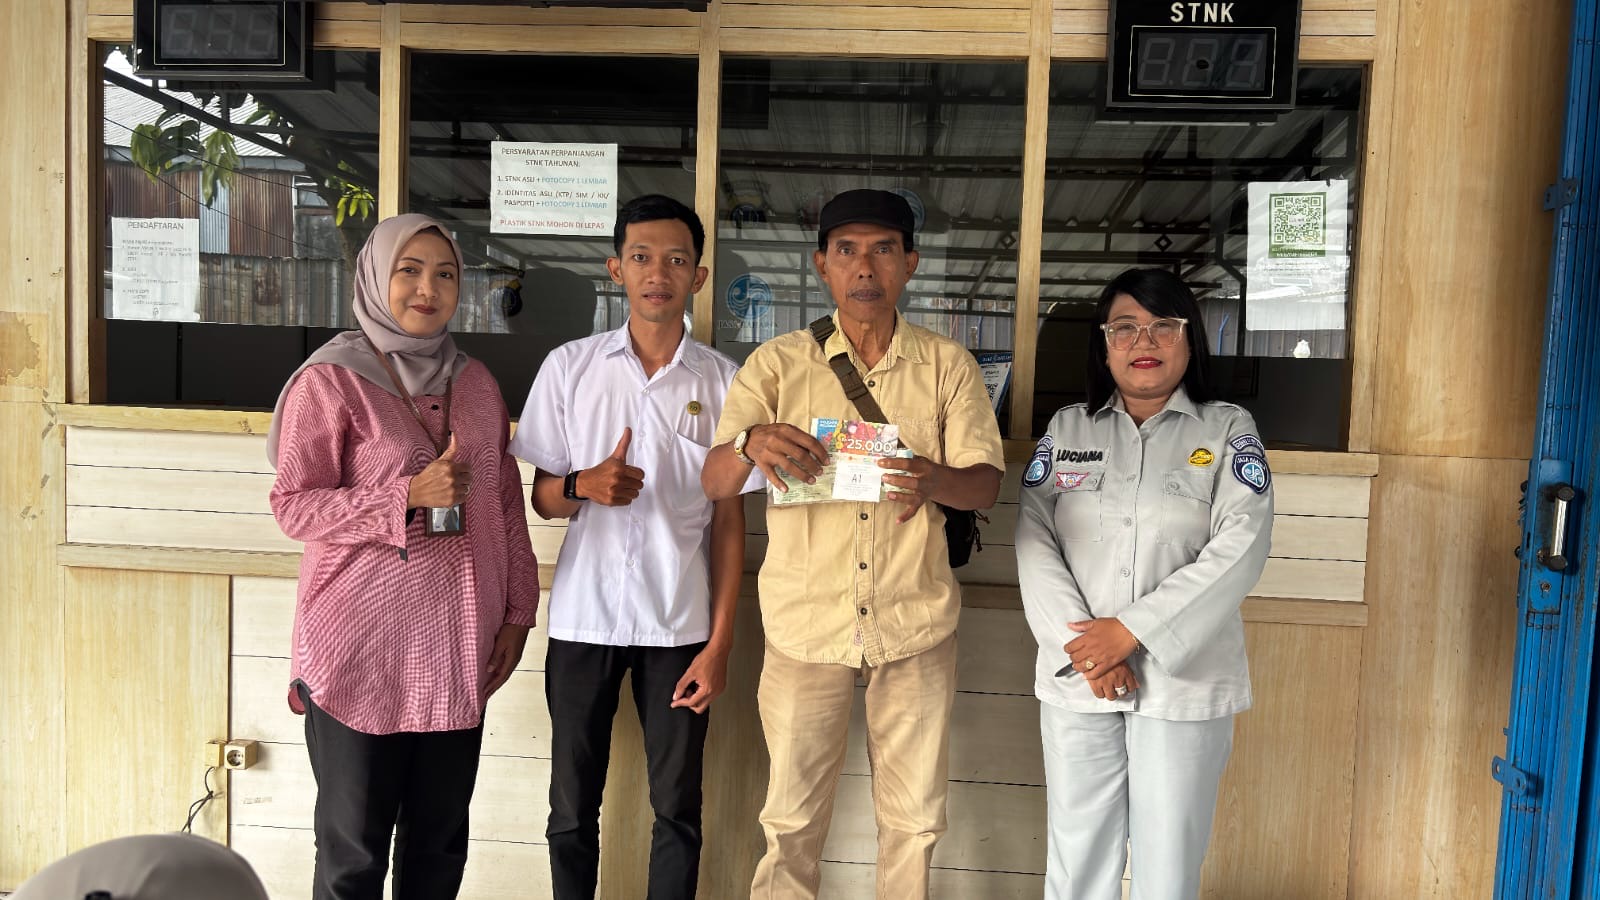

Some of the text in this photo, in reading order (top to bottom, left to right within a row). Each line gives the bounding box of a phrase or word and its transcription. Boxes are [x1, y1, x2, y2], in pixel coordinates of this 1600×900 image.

[1170, 2, 1234, 23] STNK
[502, 148, 605, 157] PERSYARATAN PERPANJANGAN
[127, 221, 184, 230] PENDAFTARAN
[846, 438, 893, 453] 25.000
[1056, 448, 1104, 463] LUCIANA
